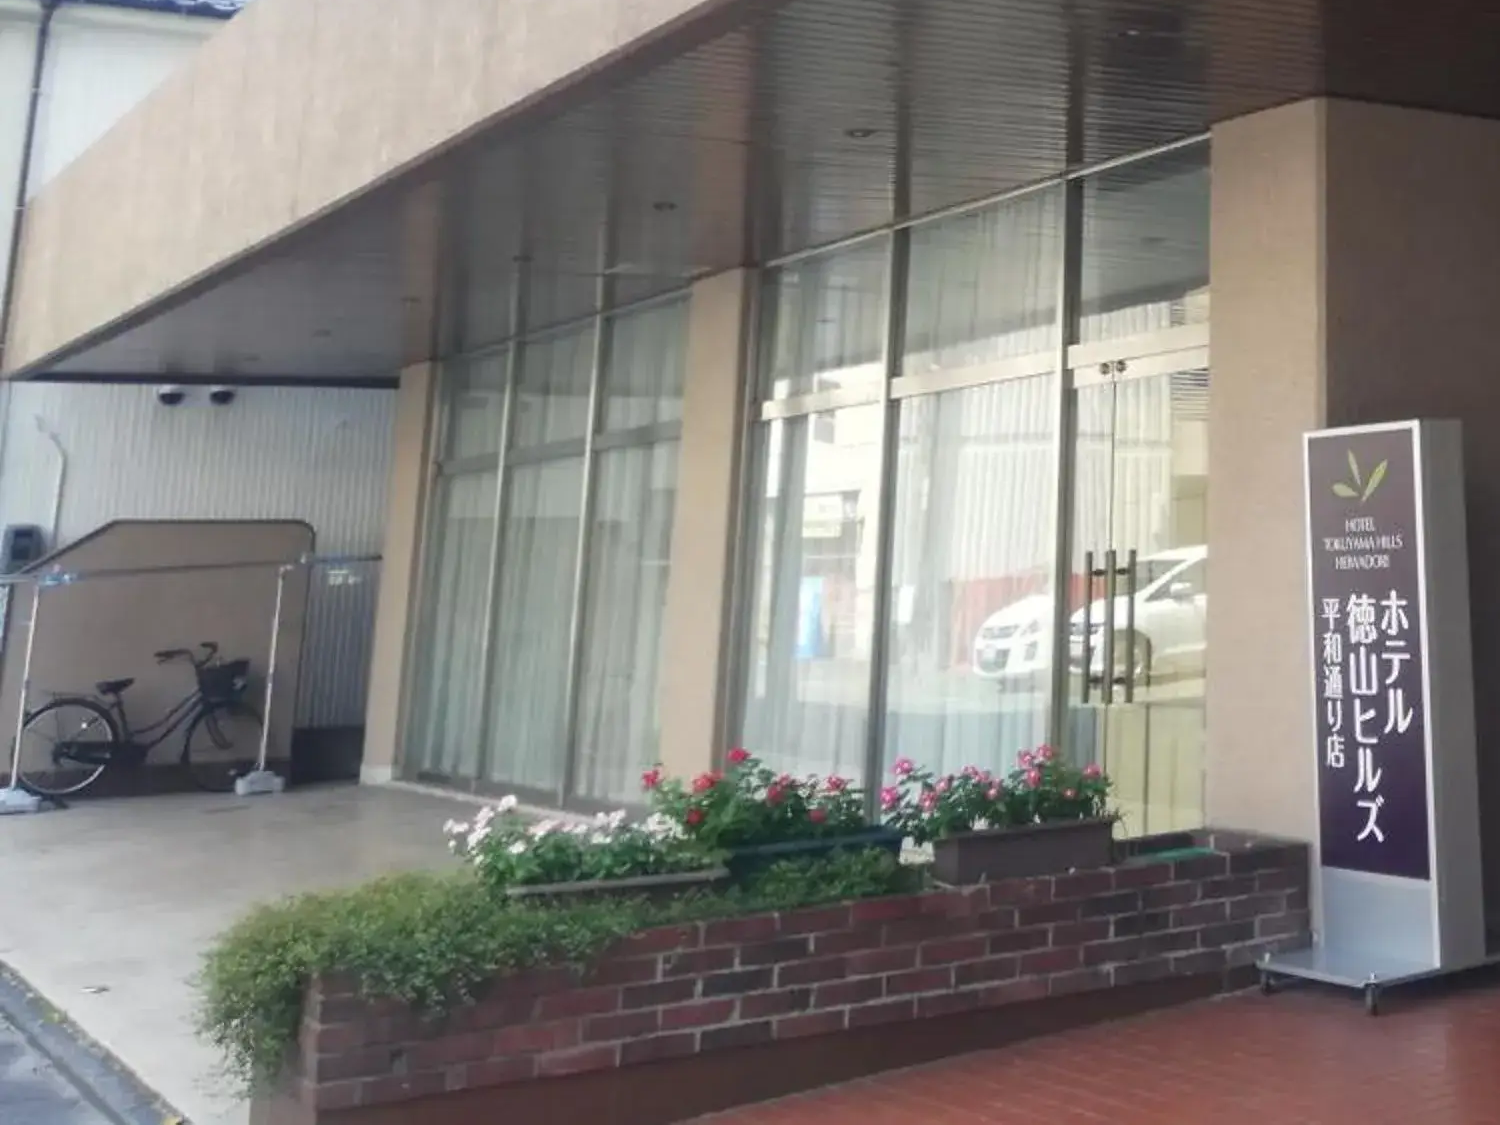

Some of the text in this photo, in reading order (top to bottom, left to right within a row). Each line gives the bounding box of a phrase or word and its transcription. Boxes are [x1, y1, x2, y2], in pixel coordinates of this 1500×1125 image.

[1323, 534, 1403, 551] TOKUYAMA HILLS
[1345, 517, 1375, 532] HOTEL
[1321, 598, 1345, 768] 平和通り店
[1346, 592, 1385, 843] 徳山ヒルズ
[1380, 589, 1413, 734] ホテル
